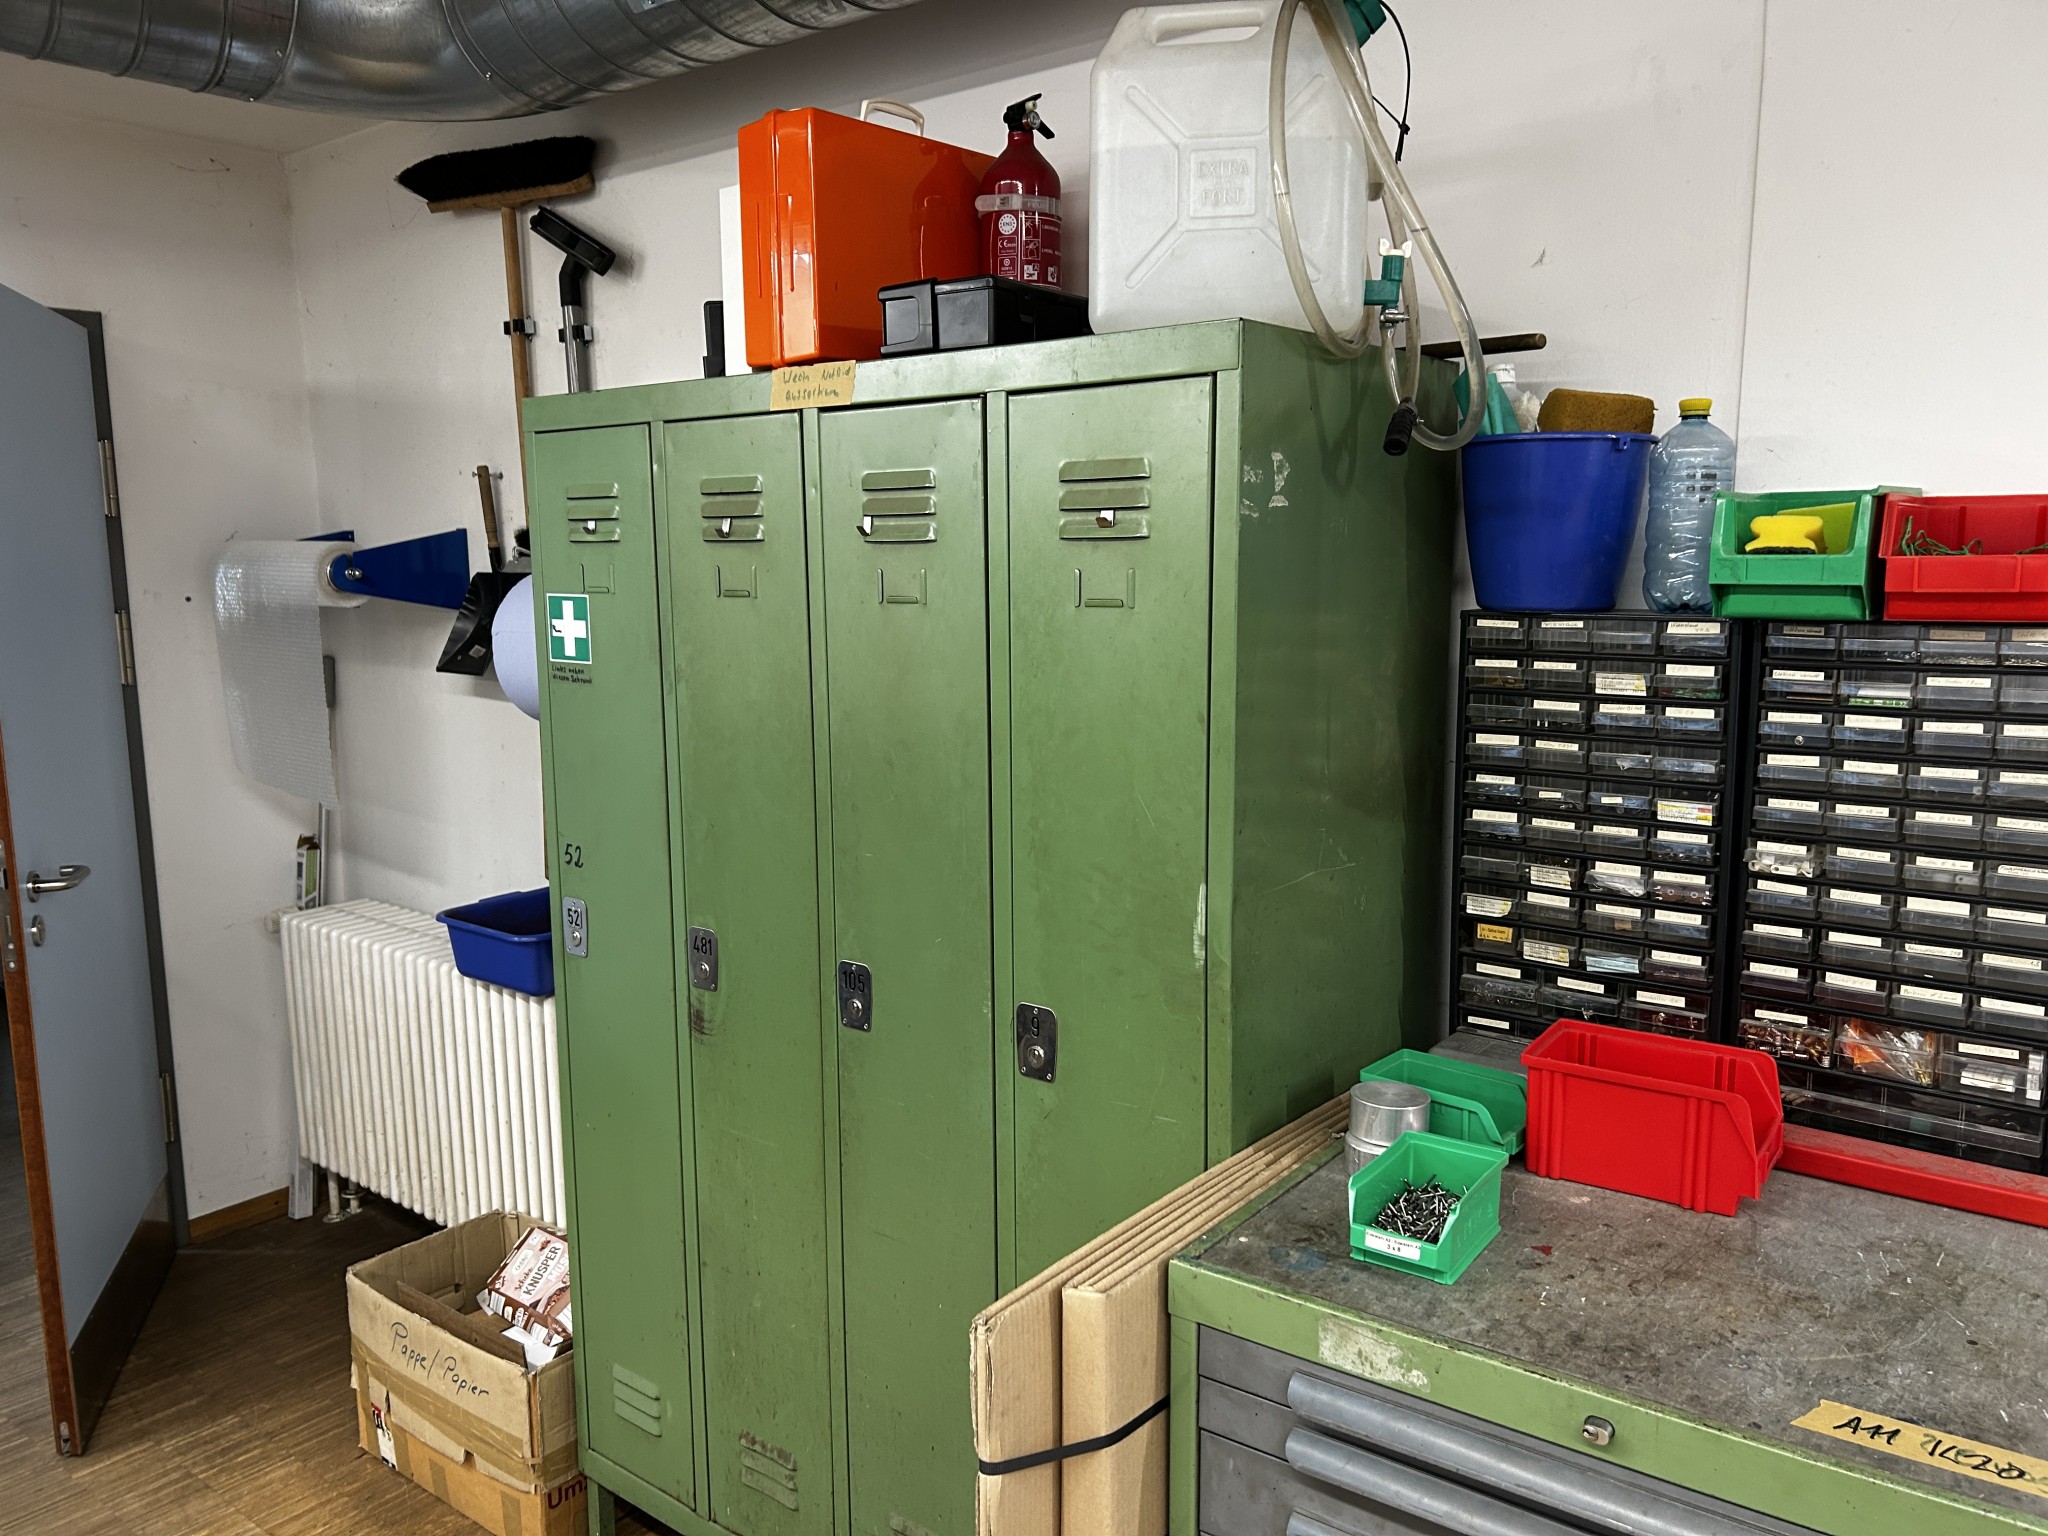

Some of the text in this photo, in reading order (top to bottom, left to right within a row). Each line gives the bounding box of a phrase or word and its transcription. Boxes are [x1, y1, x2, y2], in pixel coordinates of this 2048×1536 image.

[1197, 159, 1249, 179] EXTRA
[565, 843, 584, 869] 52
[567, 908, 581, 927] 52
[693, 935, 713, 956] 481
[843, 970, 865, 993] 105
[1031, 1016, 1040, 1038] 9
[522, 1246, 561, 1296] KNUSPER
[443, 1356, 489, 1396] Papier
[1832, 1415, 1902, 1446] AM
